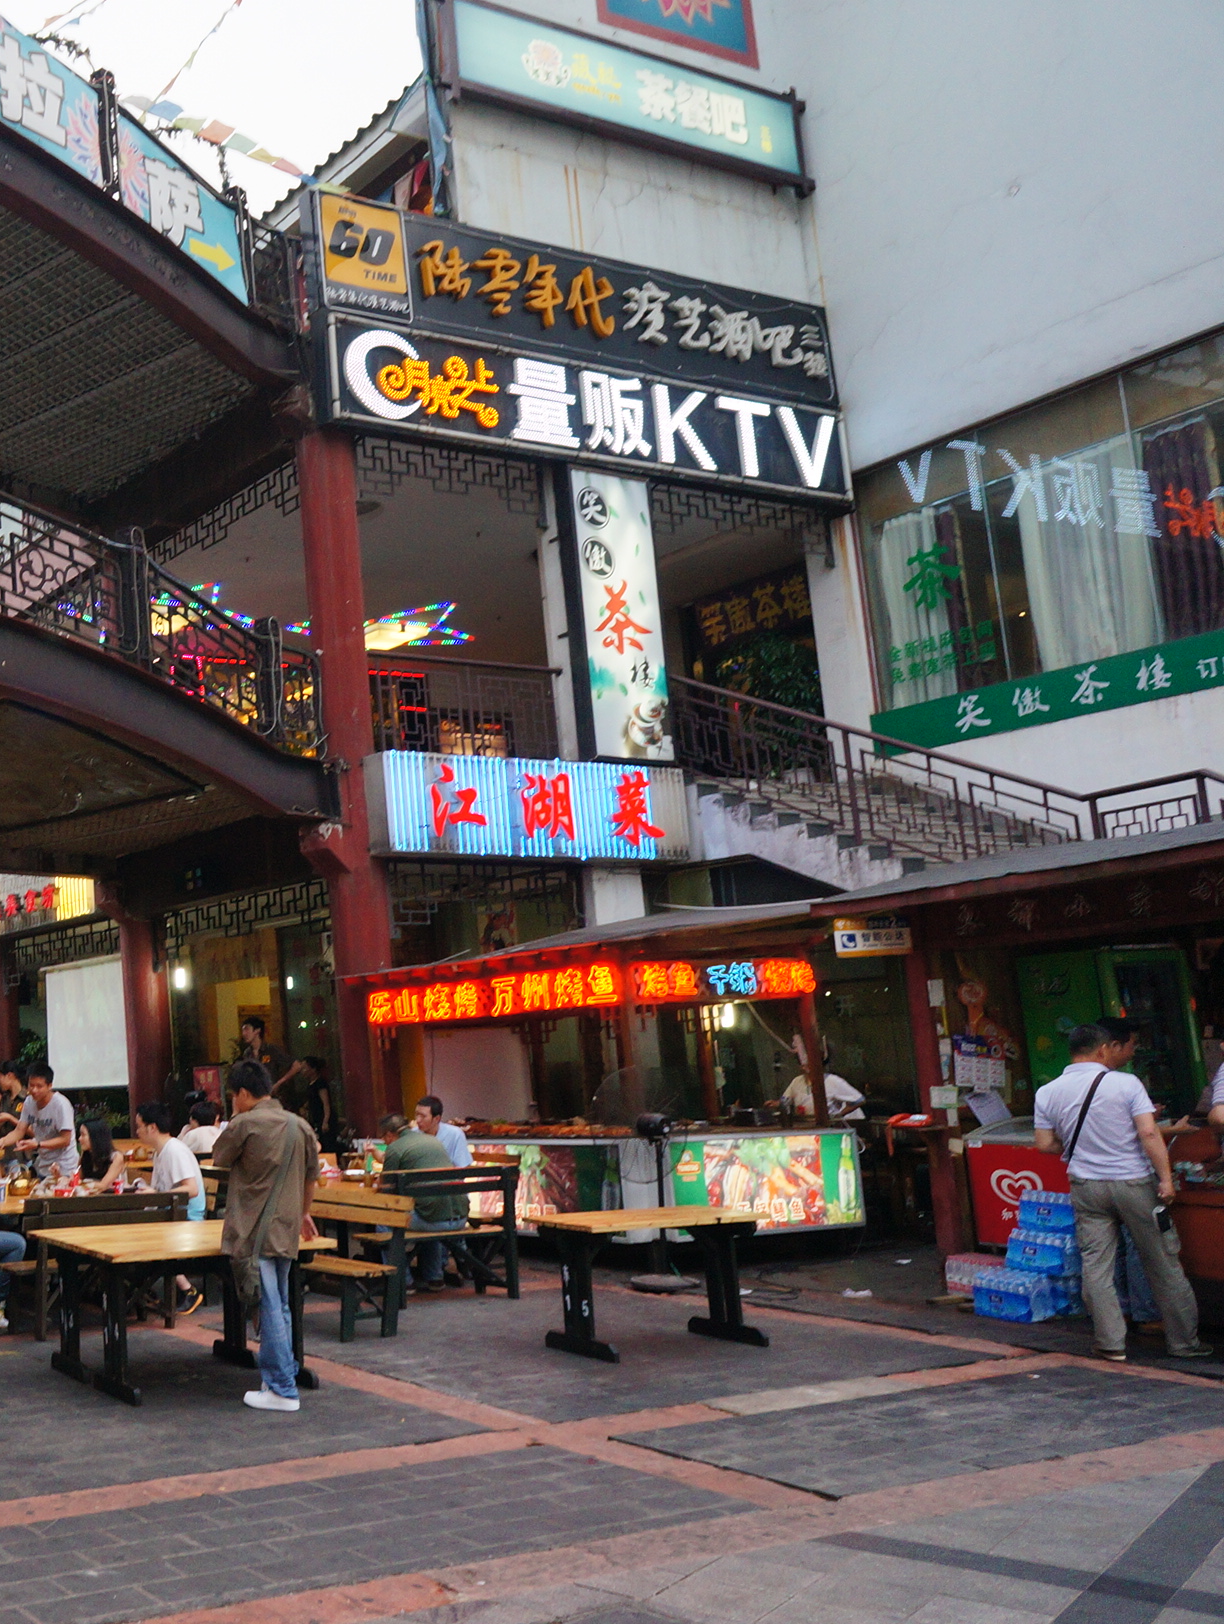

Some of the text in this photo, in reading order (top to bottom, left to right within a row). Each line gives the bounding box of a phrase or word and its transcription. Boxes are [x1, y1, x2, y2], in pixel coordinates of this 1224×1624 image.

[635, 68, 750, 145] 茶餐吧
[144, 157, 205, 247] 萨
[328, 219, 395, 266] 60
[363, 268, 398, 284] TIME
[415, 239, 616, 339] 陆零年代
[577, 487, 655, 690] 笑傲茶楼
[903, 542, 962, 610] 茶
[954, 653, 1224, 733] 笑傲茶楼 订
[428, 762, 666, 848] 江湖菜
[368, 965, 618, 1023] 乐山烧烤 万州烤鱼
[642, 961, 698, 998] 烤鱼
[706, 961, 758, 996] 干锅
